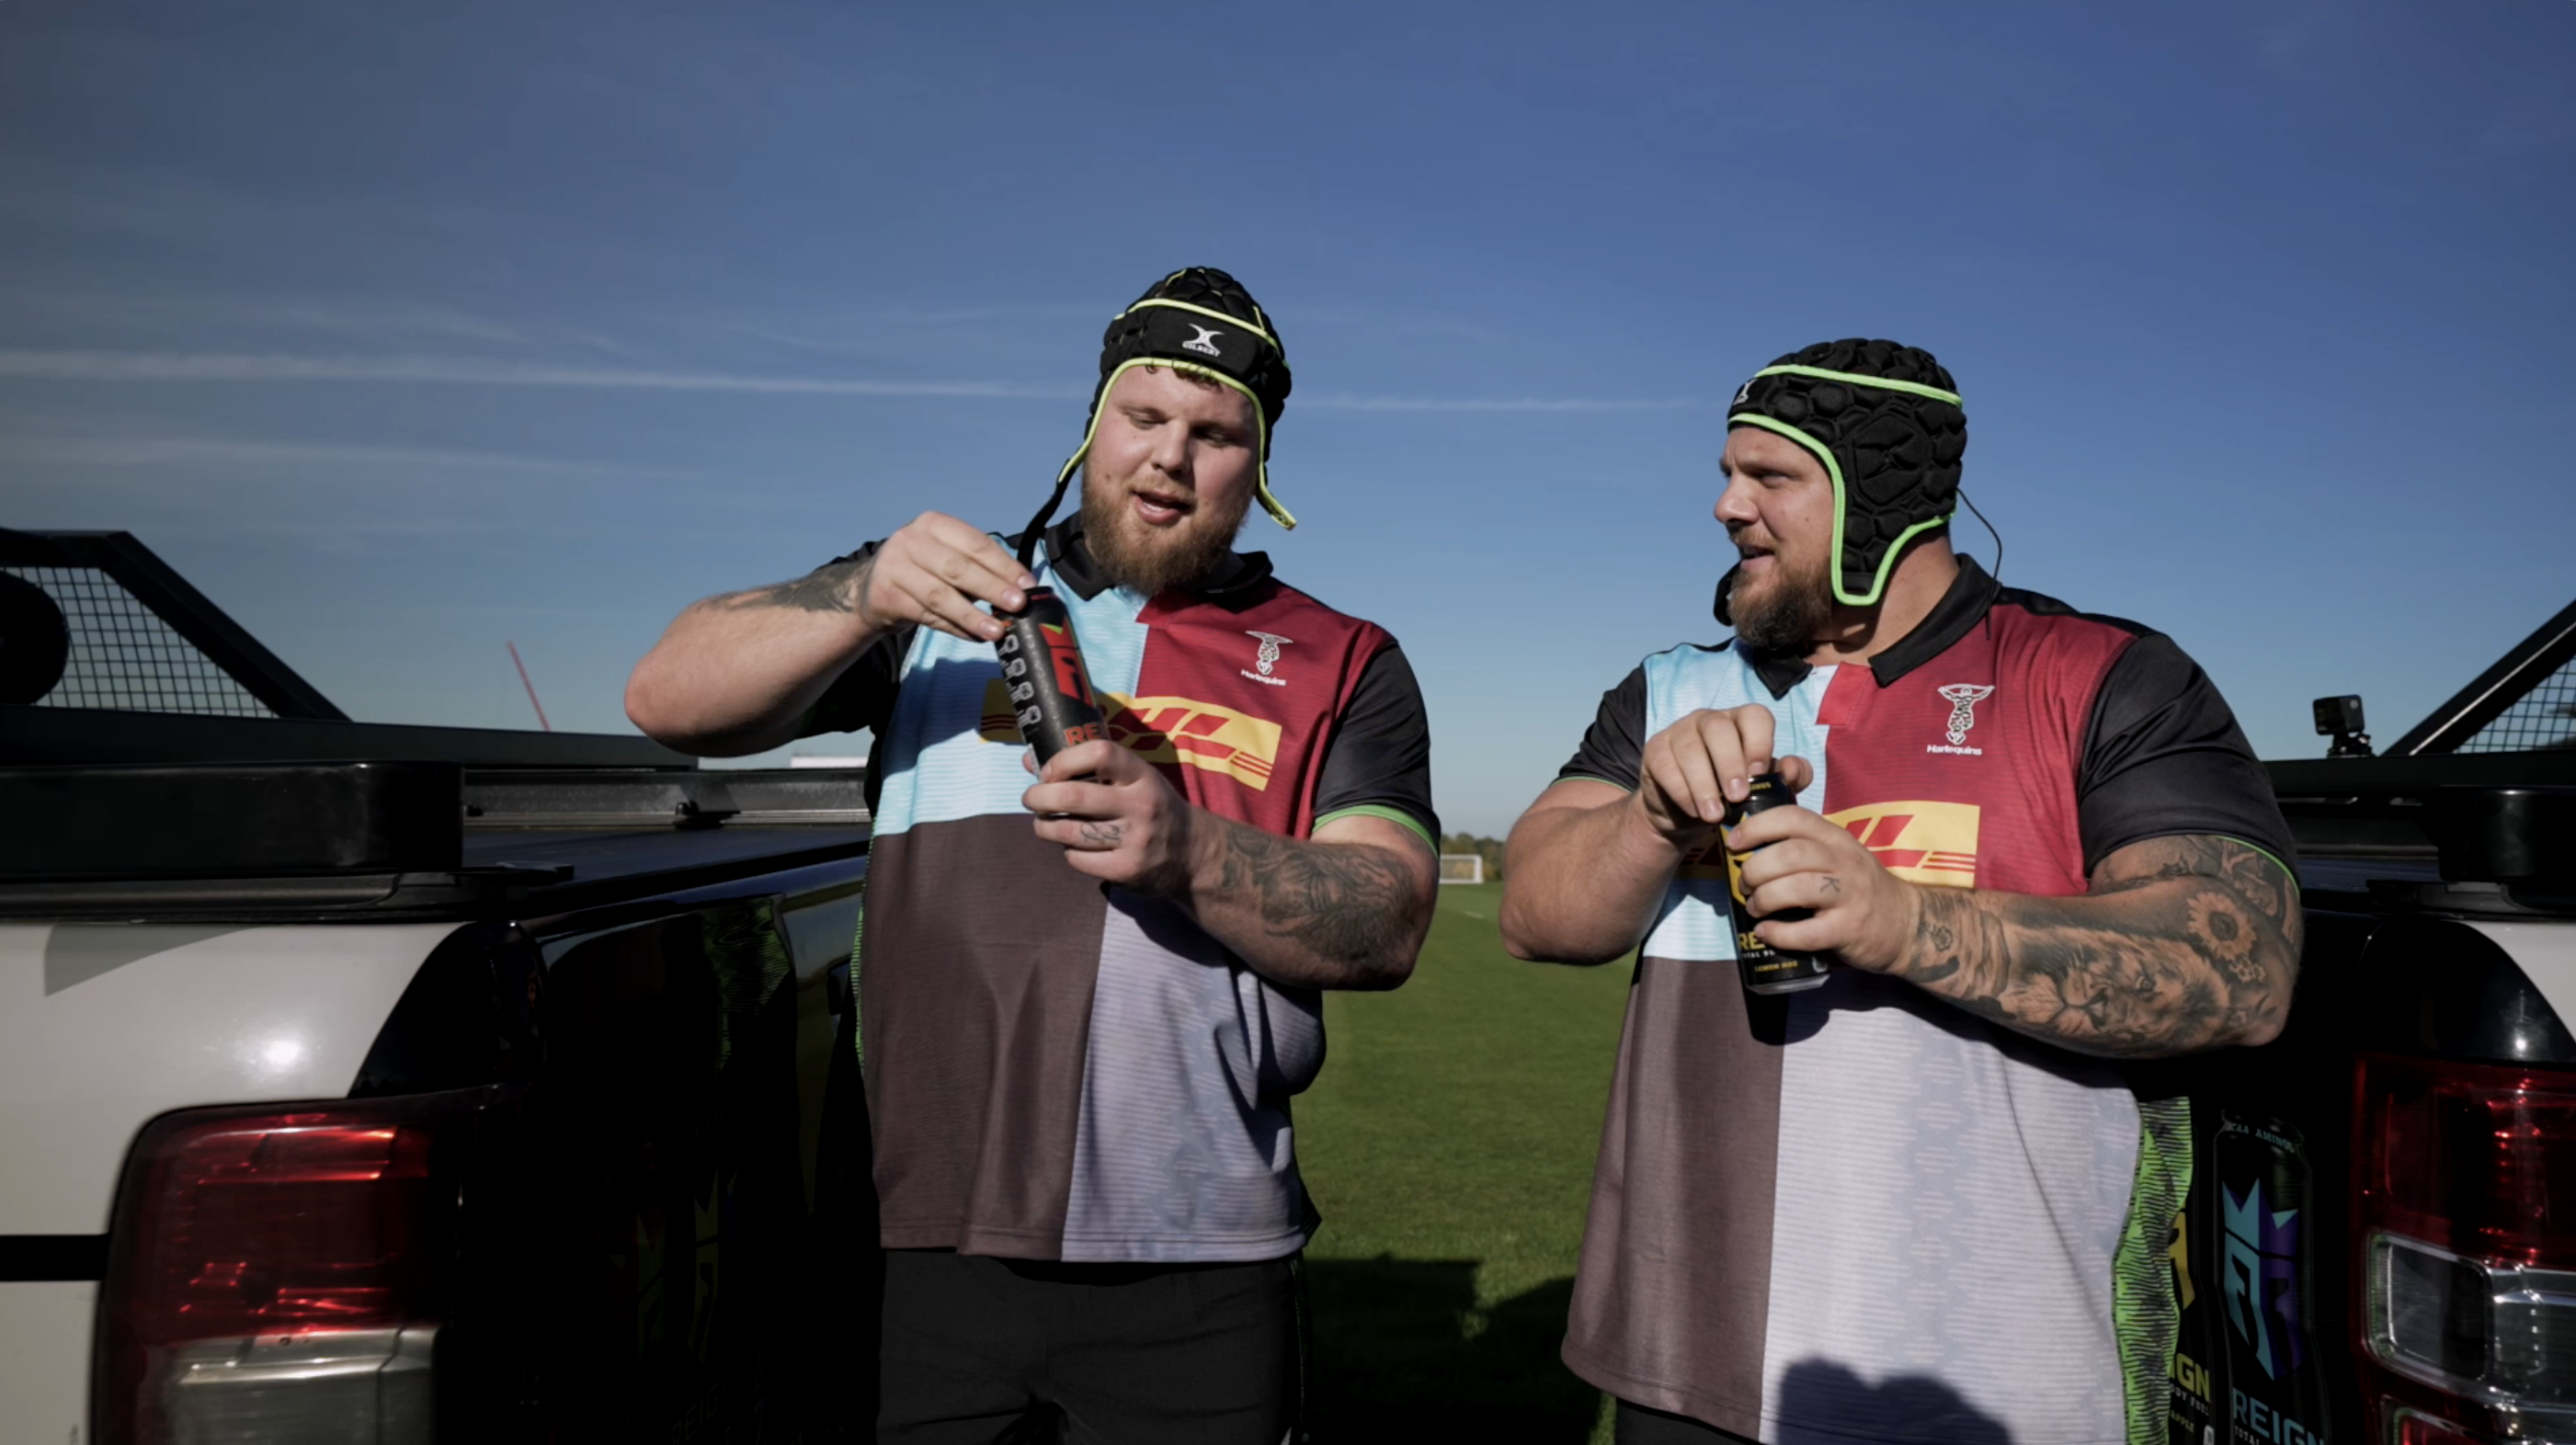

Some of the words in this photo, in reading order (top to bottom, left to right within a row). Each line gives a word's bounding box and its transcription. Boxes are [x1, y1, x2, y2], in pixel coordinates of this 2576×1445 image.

[1181, 342, 1221, 358] GILBERT
[1240, 669, 1286, 687] Harlequins
[1926, 744, 1982, 756] Harlequins
[2169, 1382, 2188, 1401] ODY
